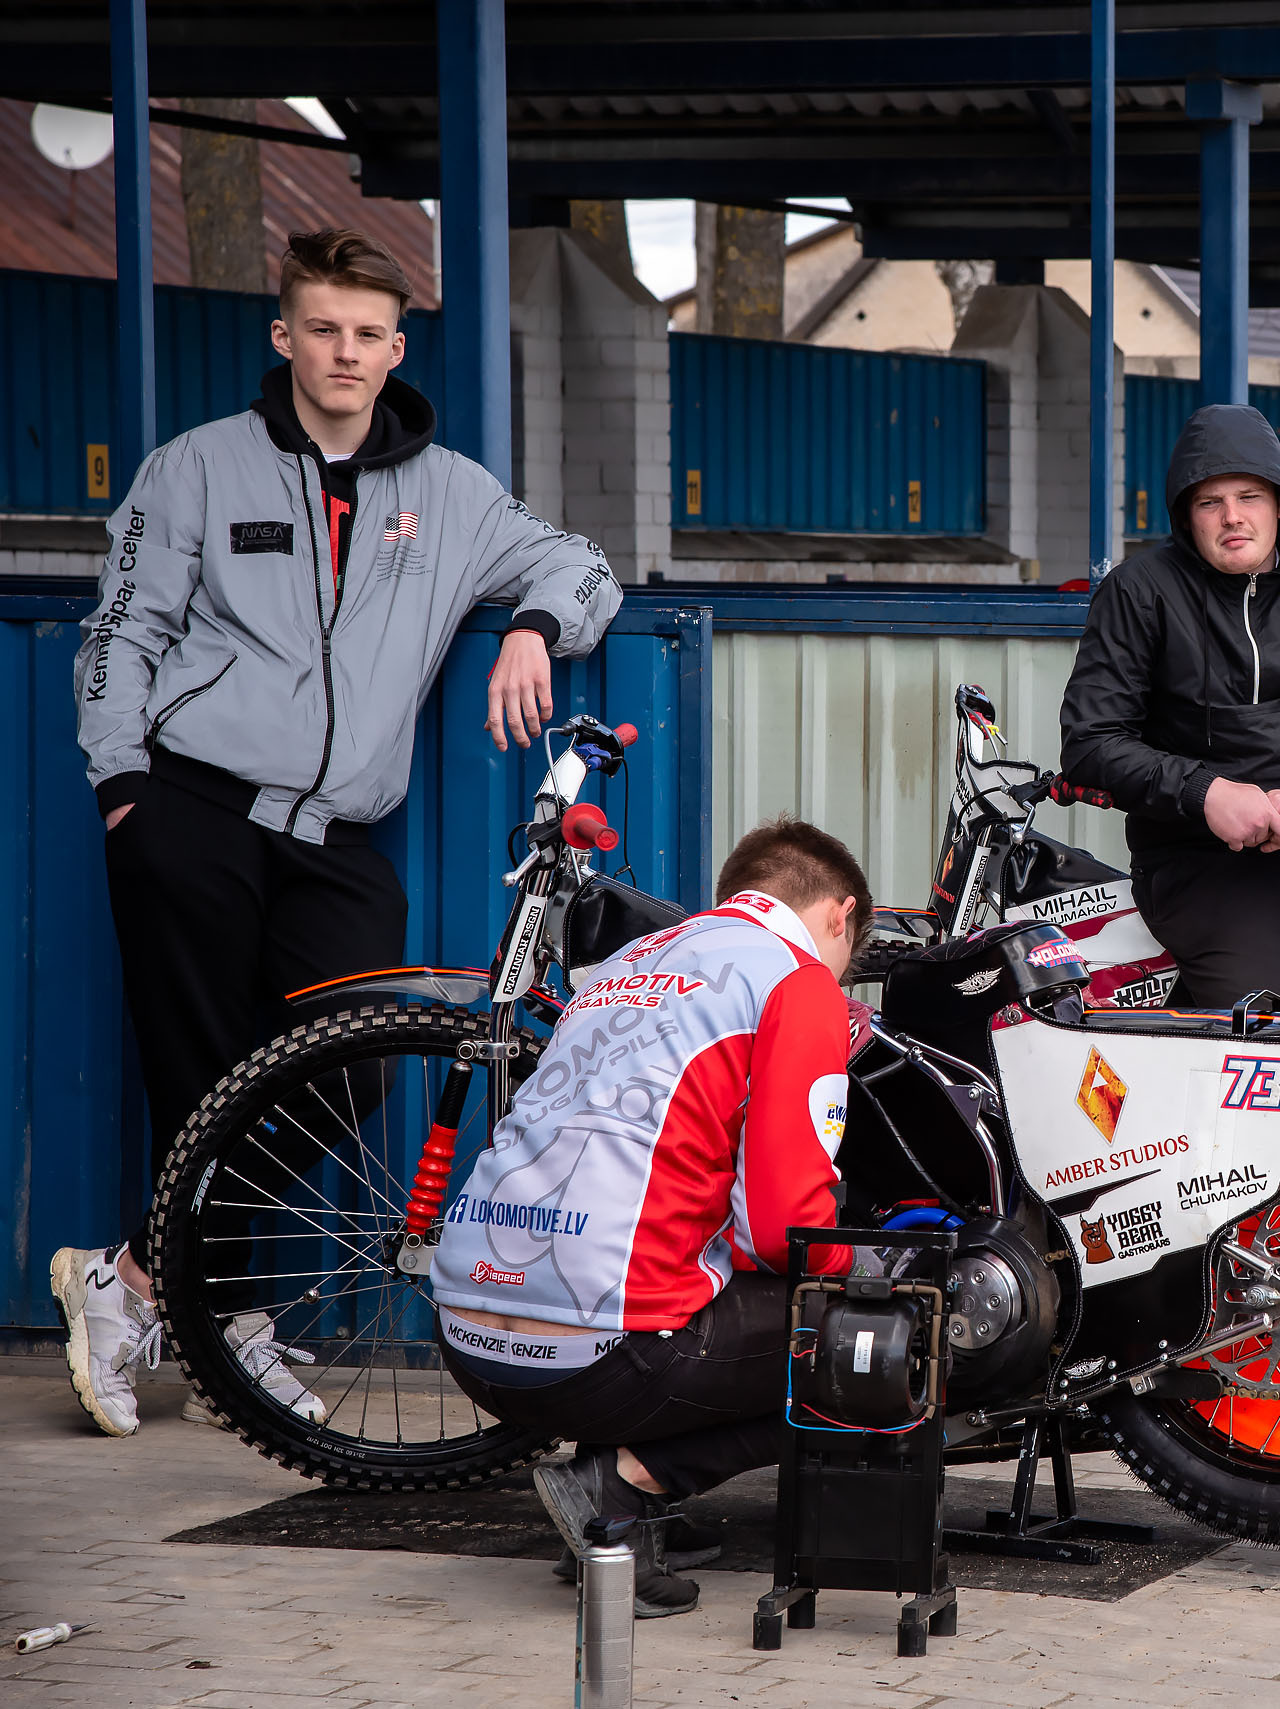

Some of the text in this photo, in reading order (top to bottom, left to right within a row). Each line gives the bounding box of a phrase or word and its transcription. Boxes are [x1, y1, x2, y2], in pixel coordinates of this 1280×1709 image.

[95, 456, 104, 486] 9
[241, 526, 285, 539] NASA
[1032, 886, 1118, 920] MIHAIL
[1045, 1134, 1190, 1190] AMBER STUDIOS
[1176, 1164, 1267, 1198] MIHAIL
[1180, 1180, 1268, 1211] CHUMAKOV
[469, 1198, 589, 1236] LOKOMOTIVE.LV
[1105, 1201, 1163, 1233] YOGGY
[1116, 1221, 1164, 1250] BEAR
[447, 1322, 507, 1354] MCKENZIE
